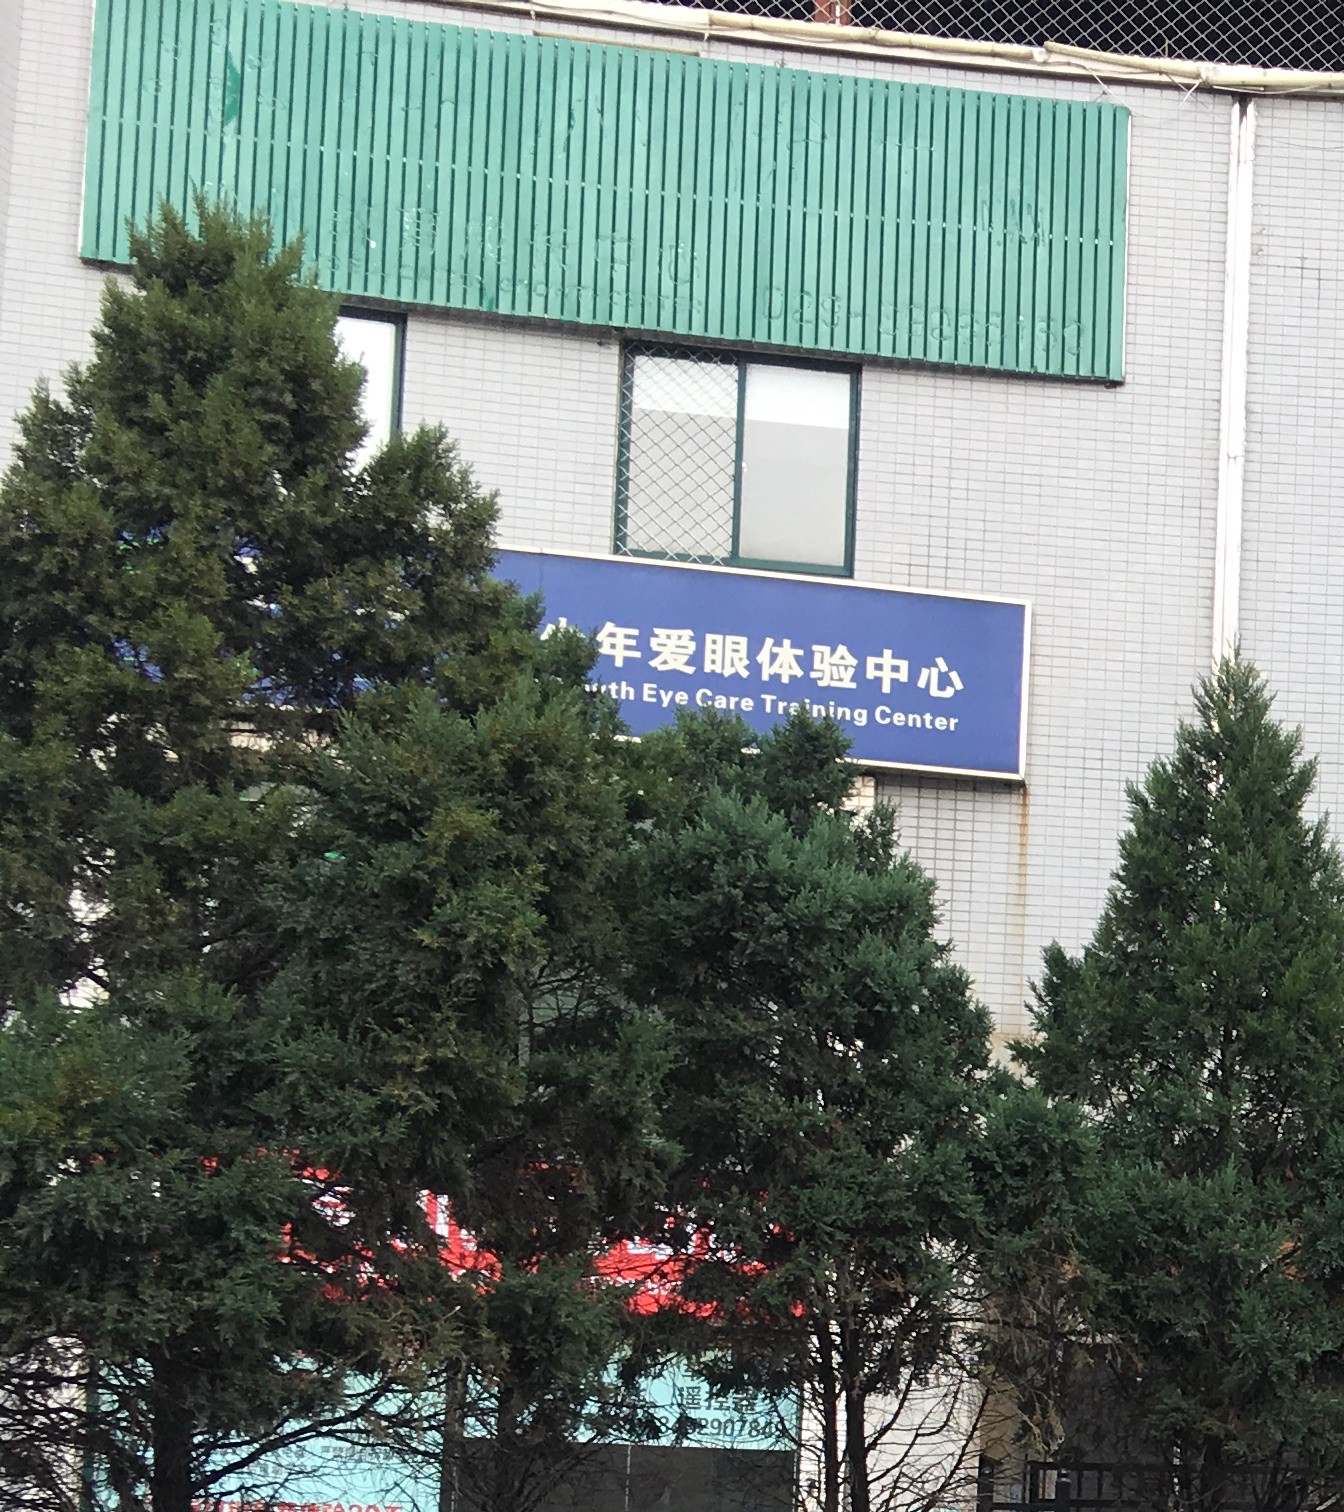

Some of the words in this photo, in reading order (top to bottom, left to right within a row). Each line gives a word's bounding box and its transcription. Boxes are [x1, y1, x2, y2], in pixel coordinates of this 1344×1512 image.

[642, 682, 689, 708] Eye
[695, 688, 755, 712] Care
[760, 694, 868, 727] Training
[874, 705, 959, 731] Center
